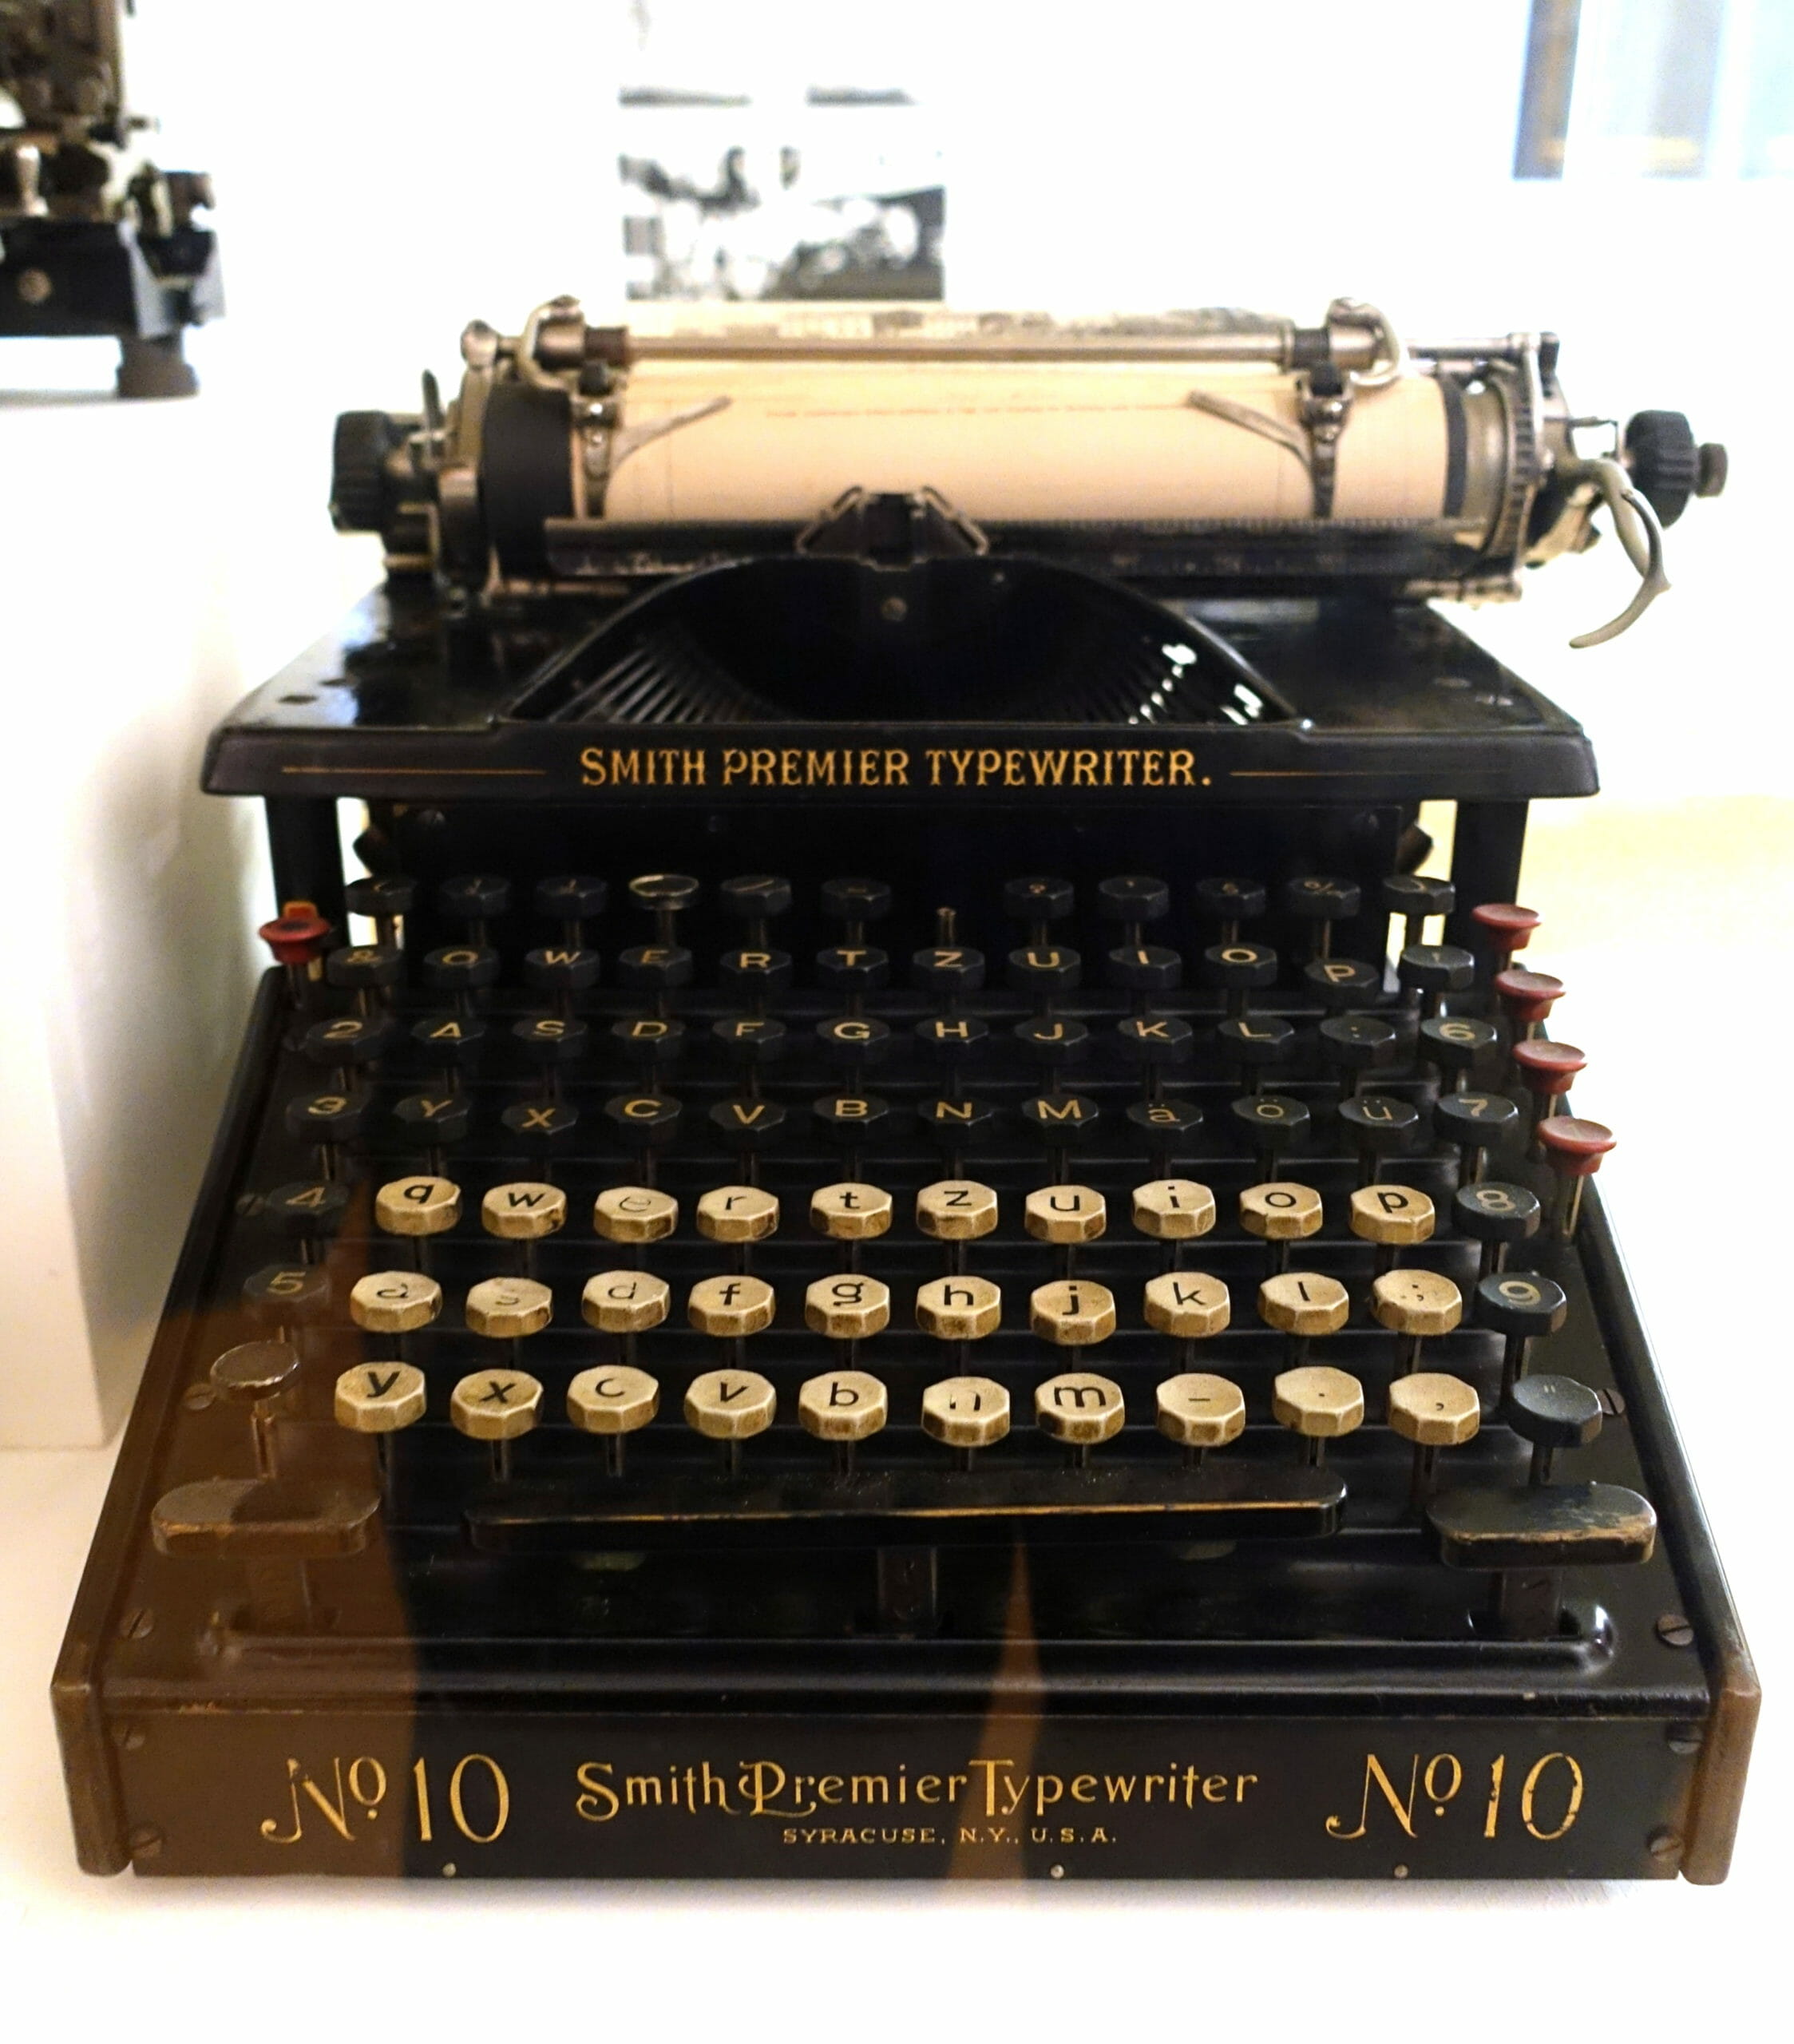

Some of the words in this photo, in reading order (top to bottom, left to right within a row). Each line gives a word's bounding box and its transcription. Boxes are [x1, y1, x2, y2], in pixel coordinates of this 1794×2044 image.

[580, 747, 705, 786] SMITH
[723, 749, 909, 786] PREMIER
[926, 749, 1211, 786] TYPEWRITER.
[545, 950, 580, 965] W
[641, 950, 671, 965] E
[740, 953, 770, 968] R
[837, 950, 867, 967] T
[934, 951, 962, 968] Z
[1028, 952, 1059, 968] U
[1222, 949, 1257, 963] O
[1324, 965, 1356, 983] P
[324, 1020, 362, 1039] 2
[430, 1022, 461, 1038] A
[536, 1020, 564, 1034] S
[632, 1021, 667, 1036] D
[735, 1022, 764, 1036] F
[834, 1022, 870, 1040] G
[935, 1021, 968, 1038] H
[1034, 1023, 1063, 1040] J
[1136, 1021, 1168, 1037] K
[1238, 1022, 1271, 1038] L
[1439, 1023, 1475, 1040] 6
[307, 1097, 346, 1115] 3
[421, 1099, 452, 1117] Y
[624, 1099, 660, 1118] C
[733, 1104, 765, 1124] V
[835, 1099, 868, 1117] B
[936, 1102, 972, 1119] N
[1037, 1099, 1082, 1119] M
[1148, 1103, 1180, 1123] ä
[1256, 1099, 1285, 1119] ö
[1362, 1100, 1393, 1121] ü
[1458, 1098, 1488, 1117] 7
[522, 1108, 554, 1127] X
[285, 1187, 326, 1208] 4
[403, 1184, 434, 1205] q
[508, 1192, 545, 1207] w
[725, 1195, 749, 1211] r
[839, 1191, 860, 1210] t
[944, 1190, 972, 1206] z
[1050, 1194, 1080, 1212] u
[1167, 1186, 1180, 1209] i
[1265, 1191, 1297, 1208] o
[1377, 1186, 1411, 1214] p
[1475, 1190, 1515, 1211] 8
[269, 1272, 306, 1294] 5
[376, 1283, 408, 1299] a
[608, 1281, 637, 1300] d
[719, 1282, 741, 1306] f
[831, 1281, 865, 1307] g
[944, 1284, 974, 1306] h
[1062, 1285, 1079, 1316] j
[1172, 1281, 1205, 1305] k
[1499, 1281, 1540, 1305] 9
[366, 1371, 400, 1398] y
[480, 1381, 516, 1404] x
[595, 1378, 625, 1398] c
[719, 1381, 748, 1403] v
[829, 1381, 859, 1407] b
[1053, 1386, 1107, 1408] m
[414, 1754, 509, 1842] 10
[576, 1761, 736, 1820] Smith
[738, 1761, 967, 1816] Premier
[968, 1759, 1258, 1817] Typewriter
[1483, 1753, 1583, 1840] 10
[783, 1828, 945, 1844] SYRACUSE,
